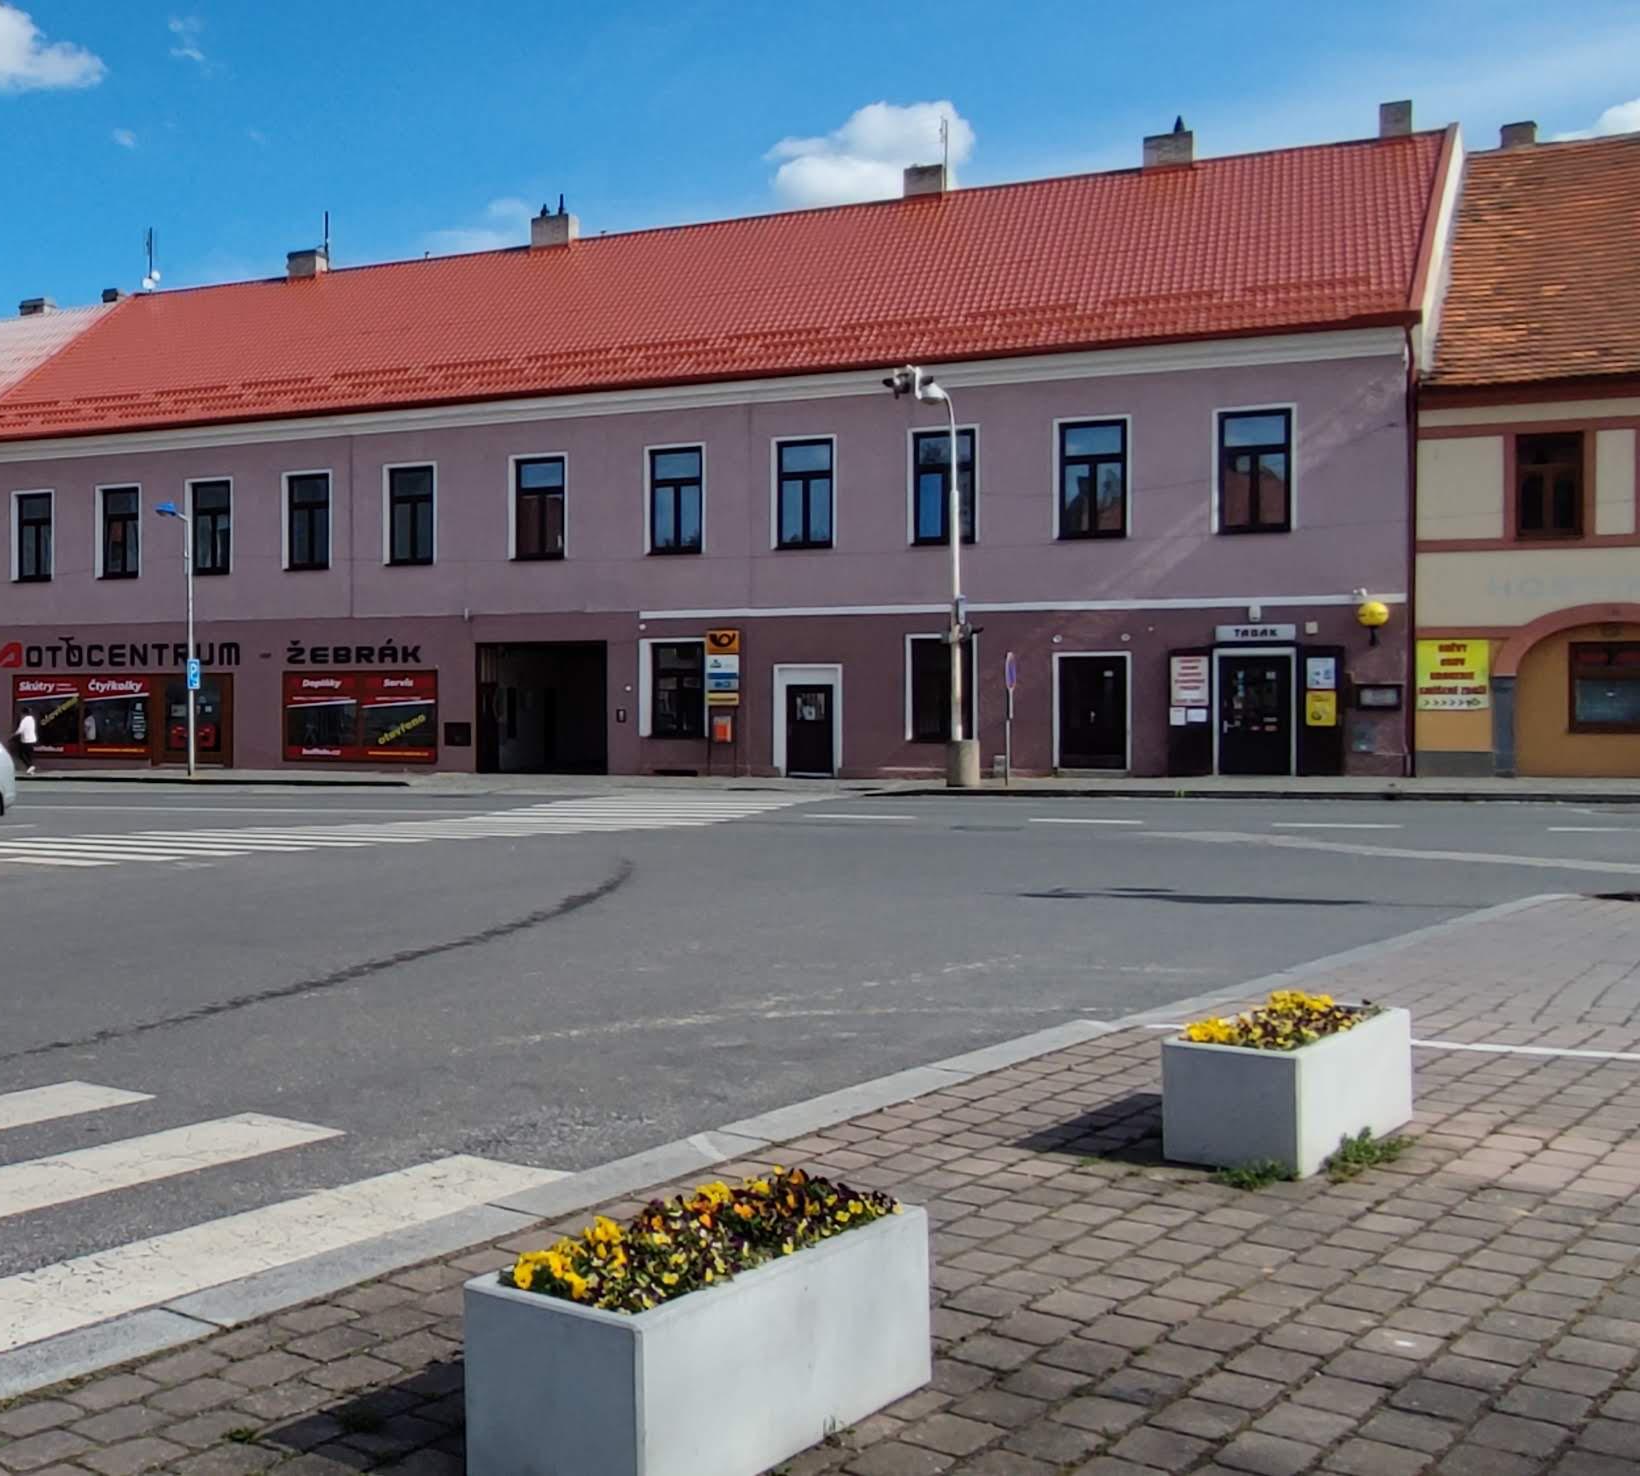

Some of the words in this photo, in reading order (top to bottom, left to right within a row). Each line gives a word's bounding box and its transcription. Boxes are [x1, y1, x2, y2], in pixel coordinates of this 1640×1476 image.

[286, 638, 421, 664] ŽEBRÁK
[18, 680, 55, 693] Skútry
[88, 679, 143, 693] Čtyřkolky
[383, 677, 414, 688] Servis
